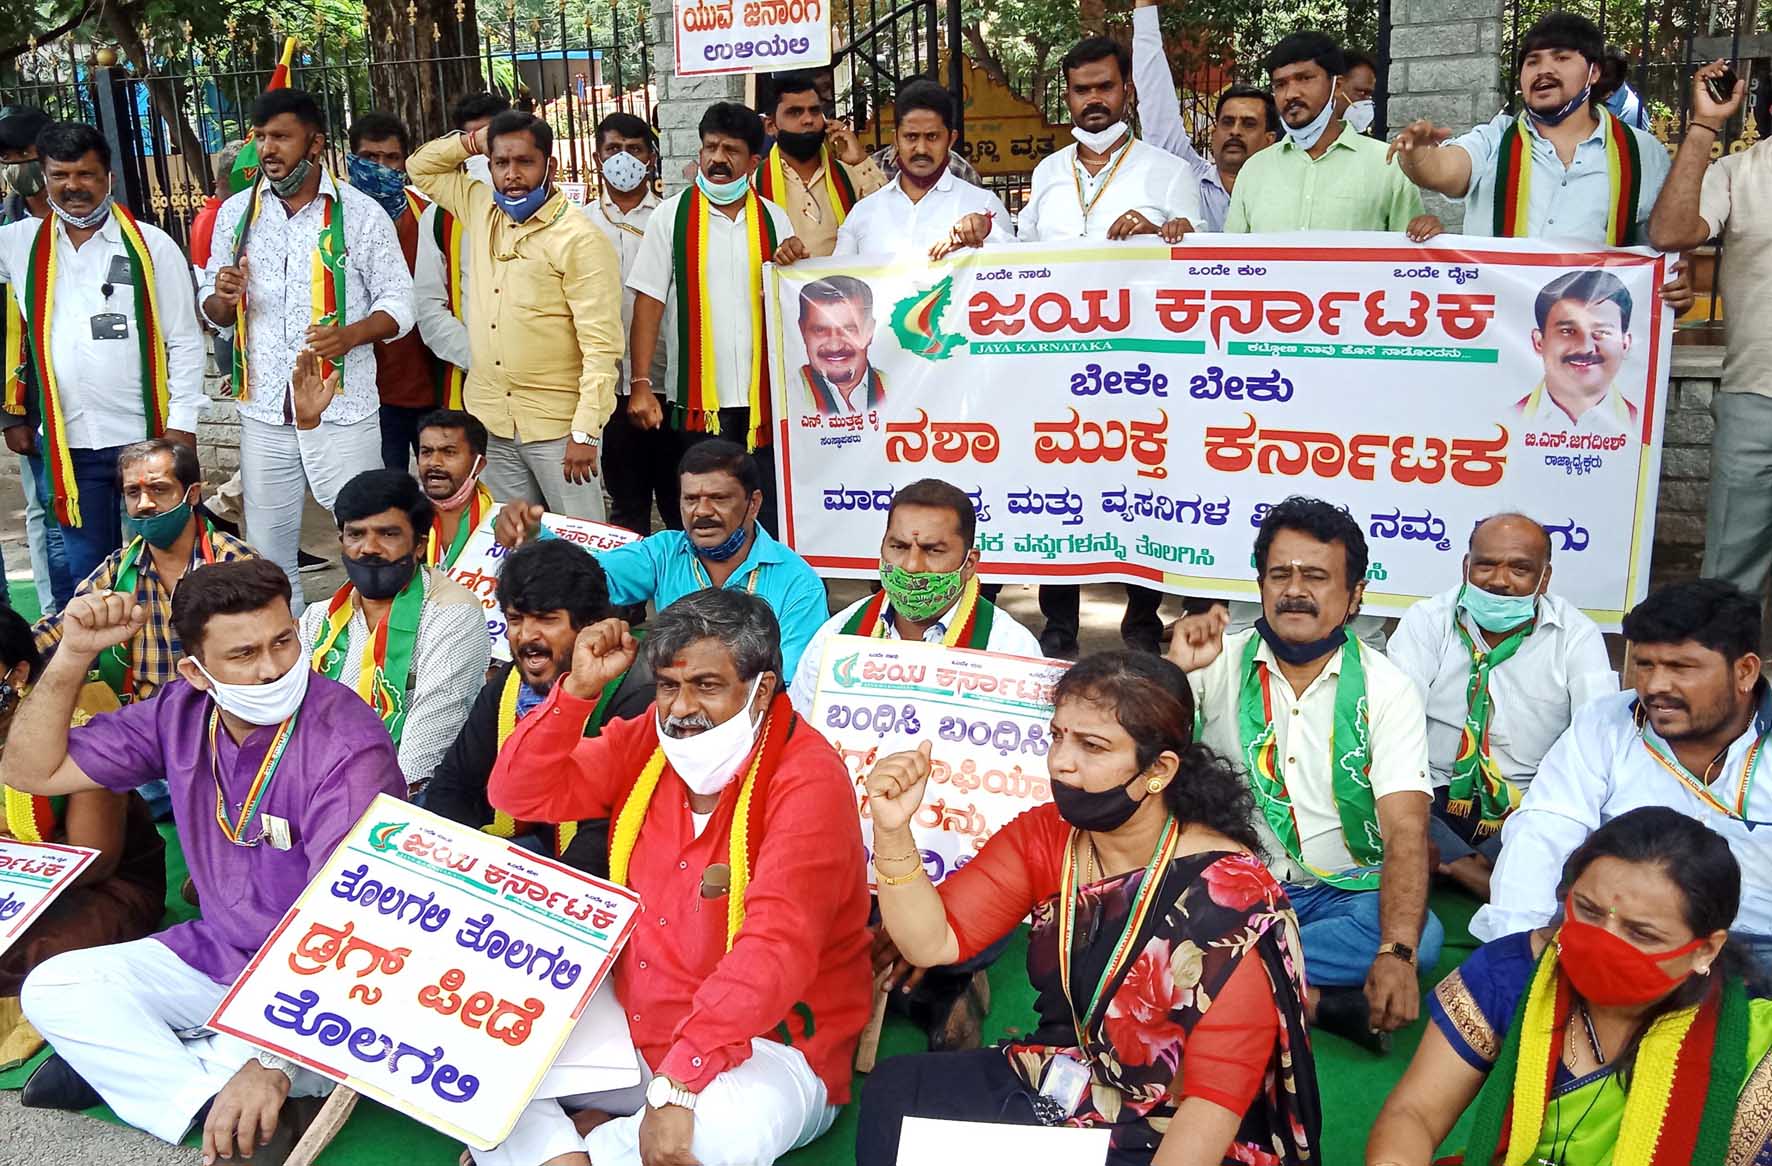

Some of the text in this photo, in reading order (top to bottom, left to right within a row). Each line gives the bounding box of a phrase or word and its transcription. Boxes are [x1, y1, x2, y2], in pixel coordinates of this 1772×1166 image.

[683, 0, 821, 32] ಯುವ ಜನಾಂಗ
[704, 34, 809, 61] ಉಳಿಯಲಿ
[976, 267, 1051, 281] ಒಂದೇ ನಾಡು
[1188, 263, 1267, 276] ಒಂದೇ ಕುಲ
[1393, 265, 1479, 285] ಒಂದೇ ದೈವ
[969, 288, 1496, 349] ಜಯ ಕರ್ನಾಟಕ
[977, 341, 1113, 354] JAYA KARNATAKA
[1070, 362, 1294, 403] ಬೇಕೇ ಬೇಕು
[801, 414, 823, 428] ಎನ್.
[829, 413, 864, 431] ಮುತ್ತಪ್ಪ
[885, 406, 1510, 487] ನಶಾ ಮುಕ್ತ ಕರ್ನಾಟಕ
[1007, 484, 1084, 525] ಮತ್ತು
[1101, 483, 1231, 526] ವ್ಯಸನಿಗಳ
[1369, 506, 1452, 552] ನಮ್ಮ
[1013, 531, 1127, 560] ವಸ್ತುಗಳನ್ನು
[1135, 534, 1215, 566] ತೊಲಗಿಸಿ
[863, 660, 926, 683] ಜಯ
[826, 703, 1049, 757] ಬಂಧಿಸಿ ಬಂಧಿಸಿ
[403, 833, 479, 872] ಜಯ
[484, 863, 618, 929] ಕರ್ನಾಟಕ
[330, 864, 451, 933] ತೊಲಗಲಿ
[455, 913, 582, 991] ತೊಲಗಲಿ
[288, 921, 545, 1046] ಡ್ರಗ್ಸ್ ಪೀಡೆ
[263, 989, 480, 1105] ತೊಲಗಲಿ
